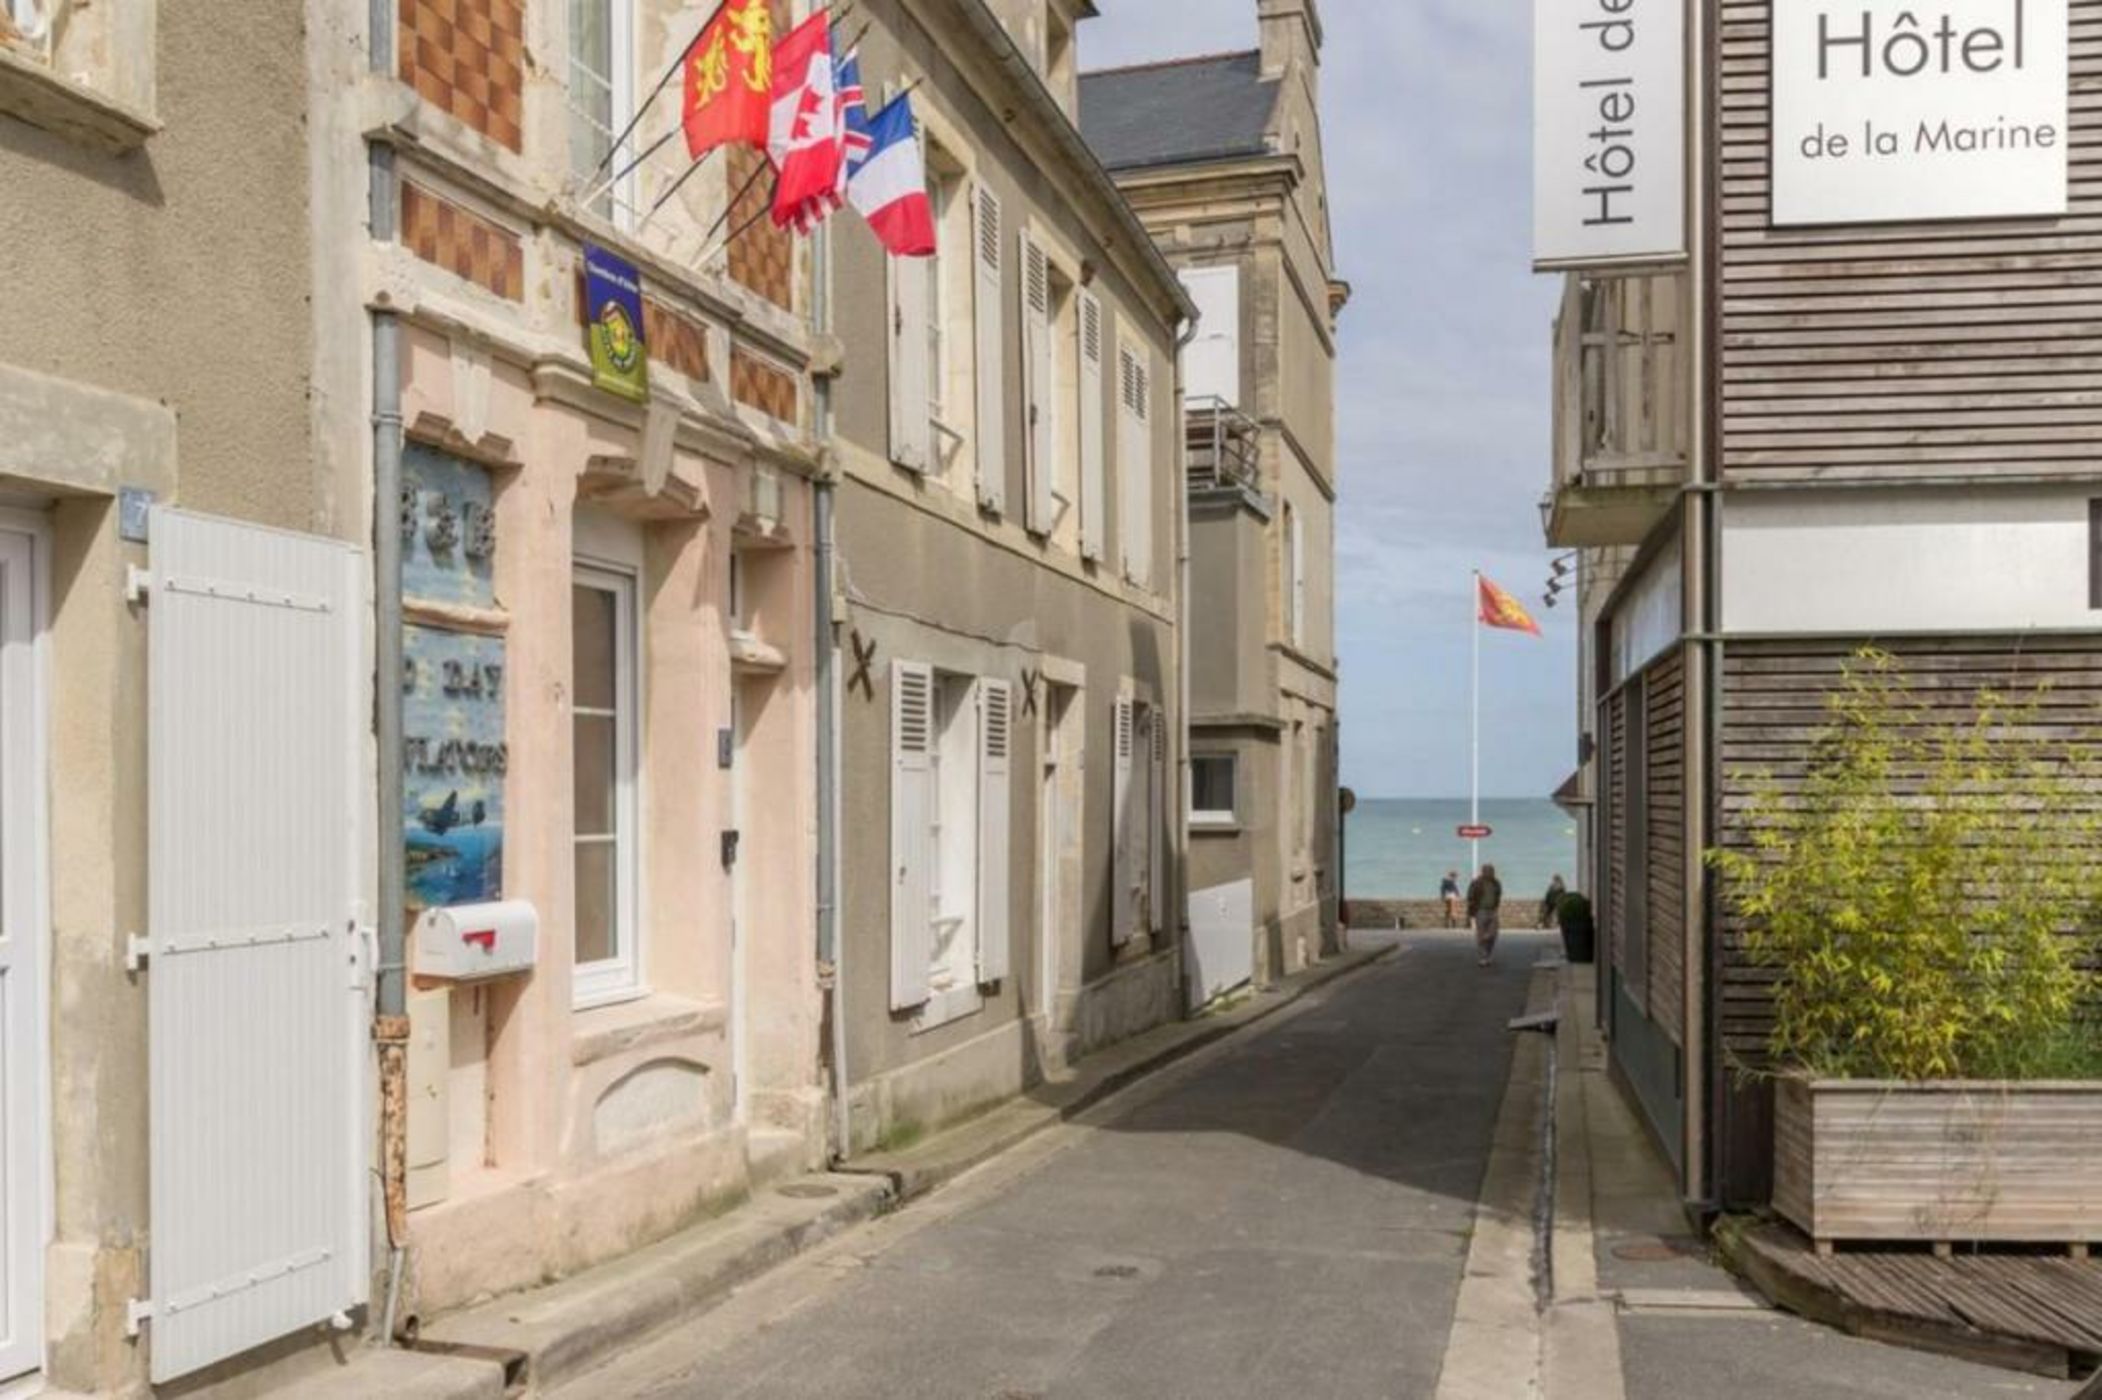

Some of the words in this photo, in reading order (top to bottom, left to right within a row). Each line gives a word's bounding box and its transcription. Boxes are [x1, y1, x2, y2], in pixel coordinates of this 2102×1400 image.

[1817, 0, 2023, 80] Hôtel
[1579, 77, 1635, 227] Hôtel
[1800, 123, 1848, 159] de
[1865, 121, 1898, 155] la
[1914, 117, 2056, 153] Marine
